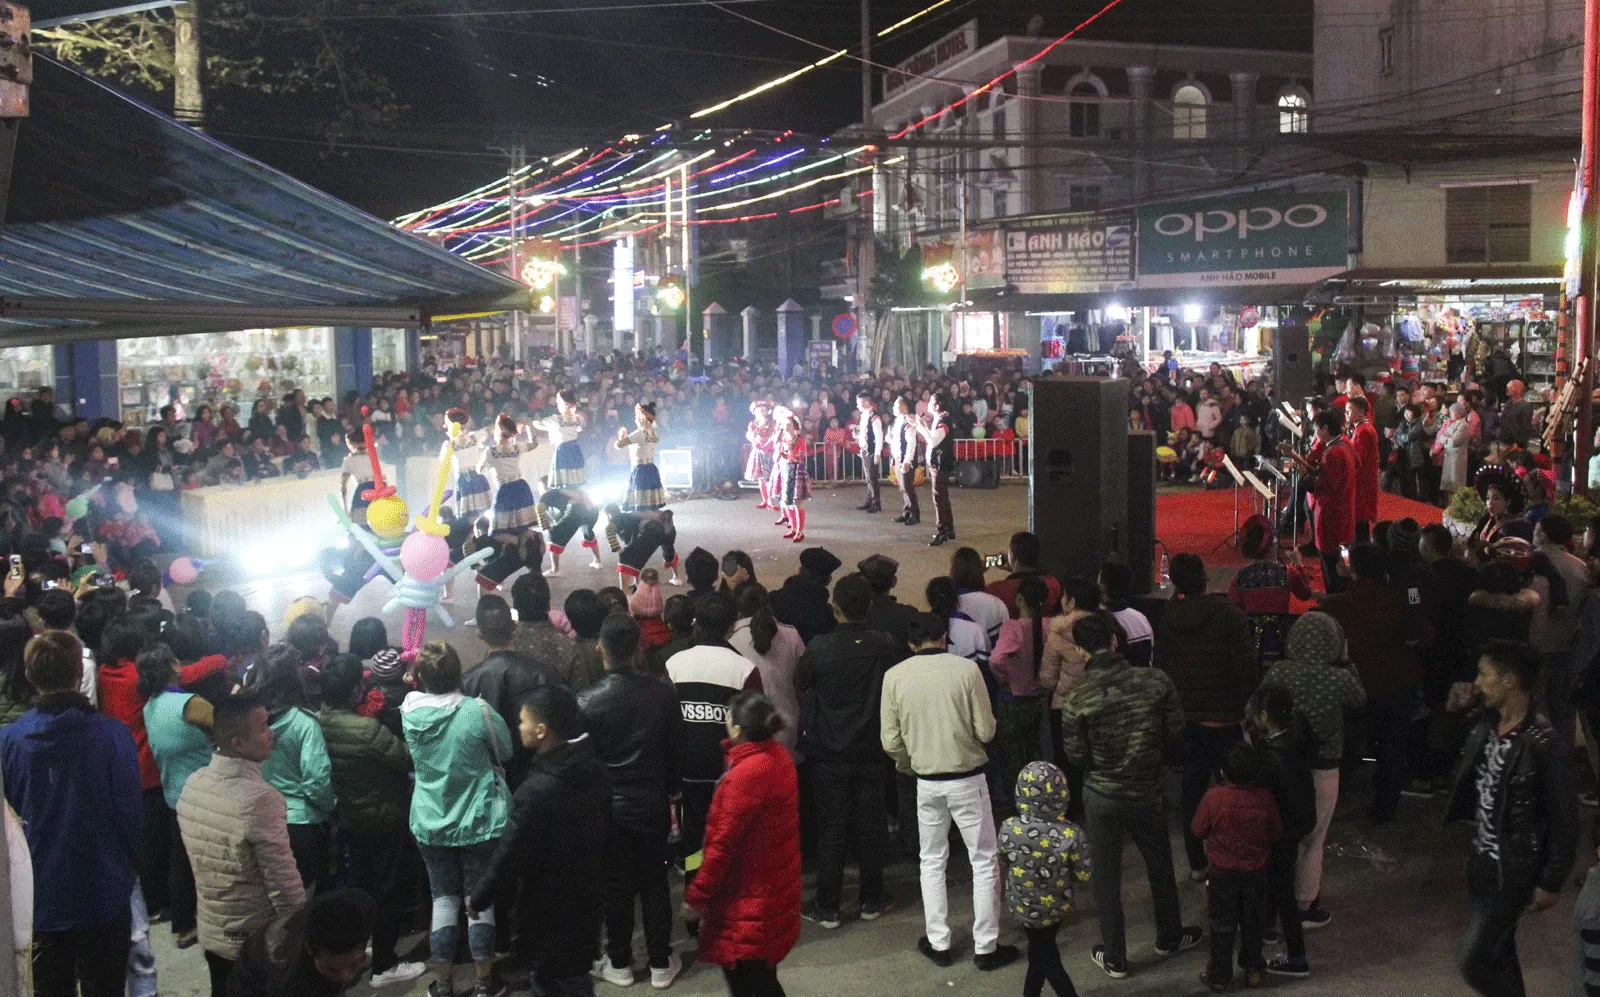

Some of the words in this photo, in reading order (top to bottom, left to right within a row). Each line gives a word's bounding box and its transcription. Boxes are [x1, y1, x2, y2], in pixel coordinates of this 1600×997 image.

[1028, 232, 1063, 252] ANH
[1166, 245, 1313, 263] SMARTPHONE
[1200, 273, 1219, 282] ANH
[1245, 271, 1277, 281] MOBILE
